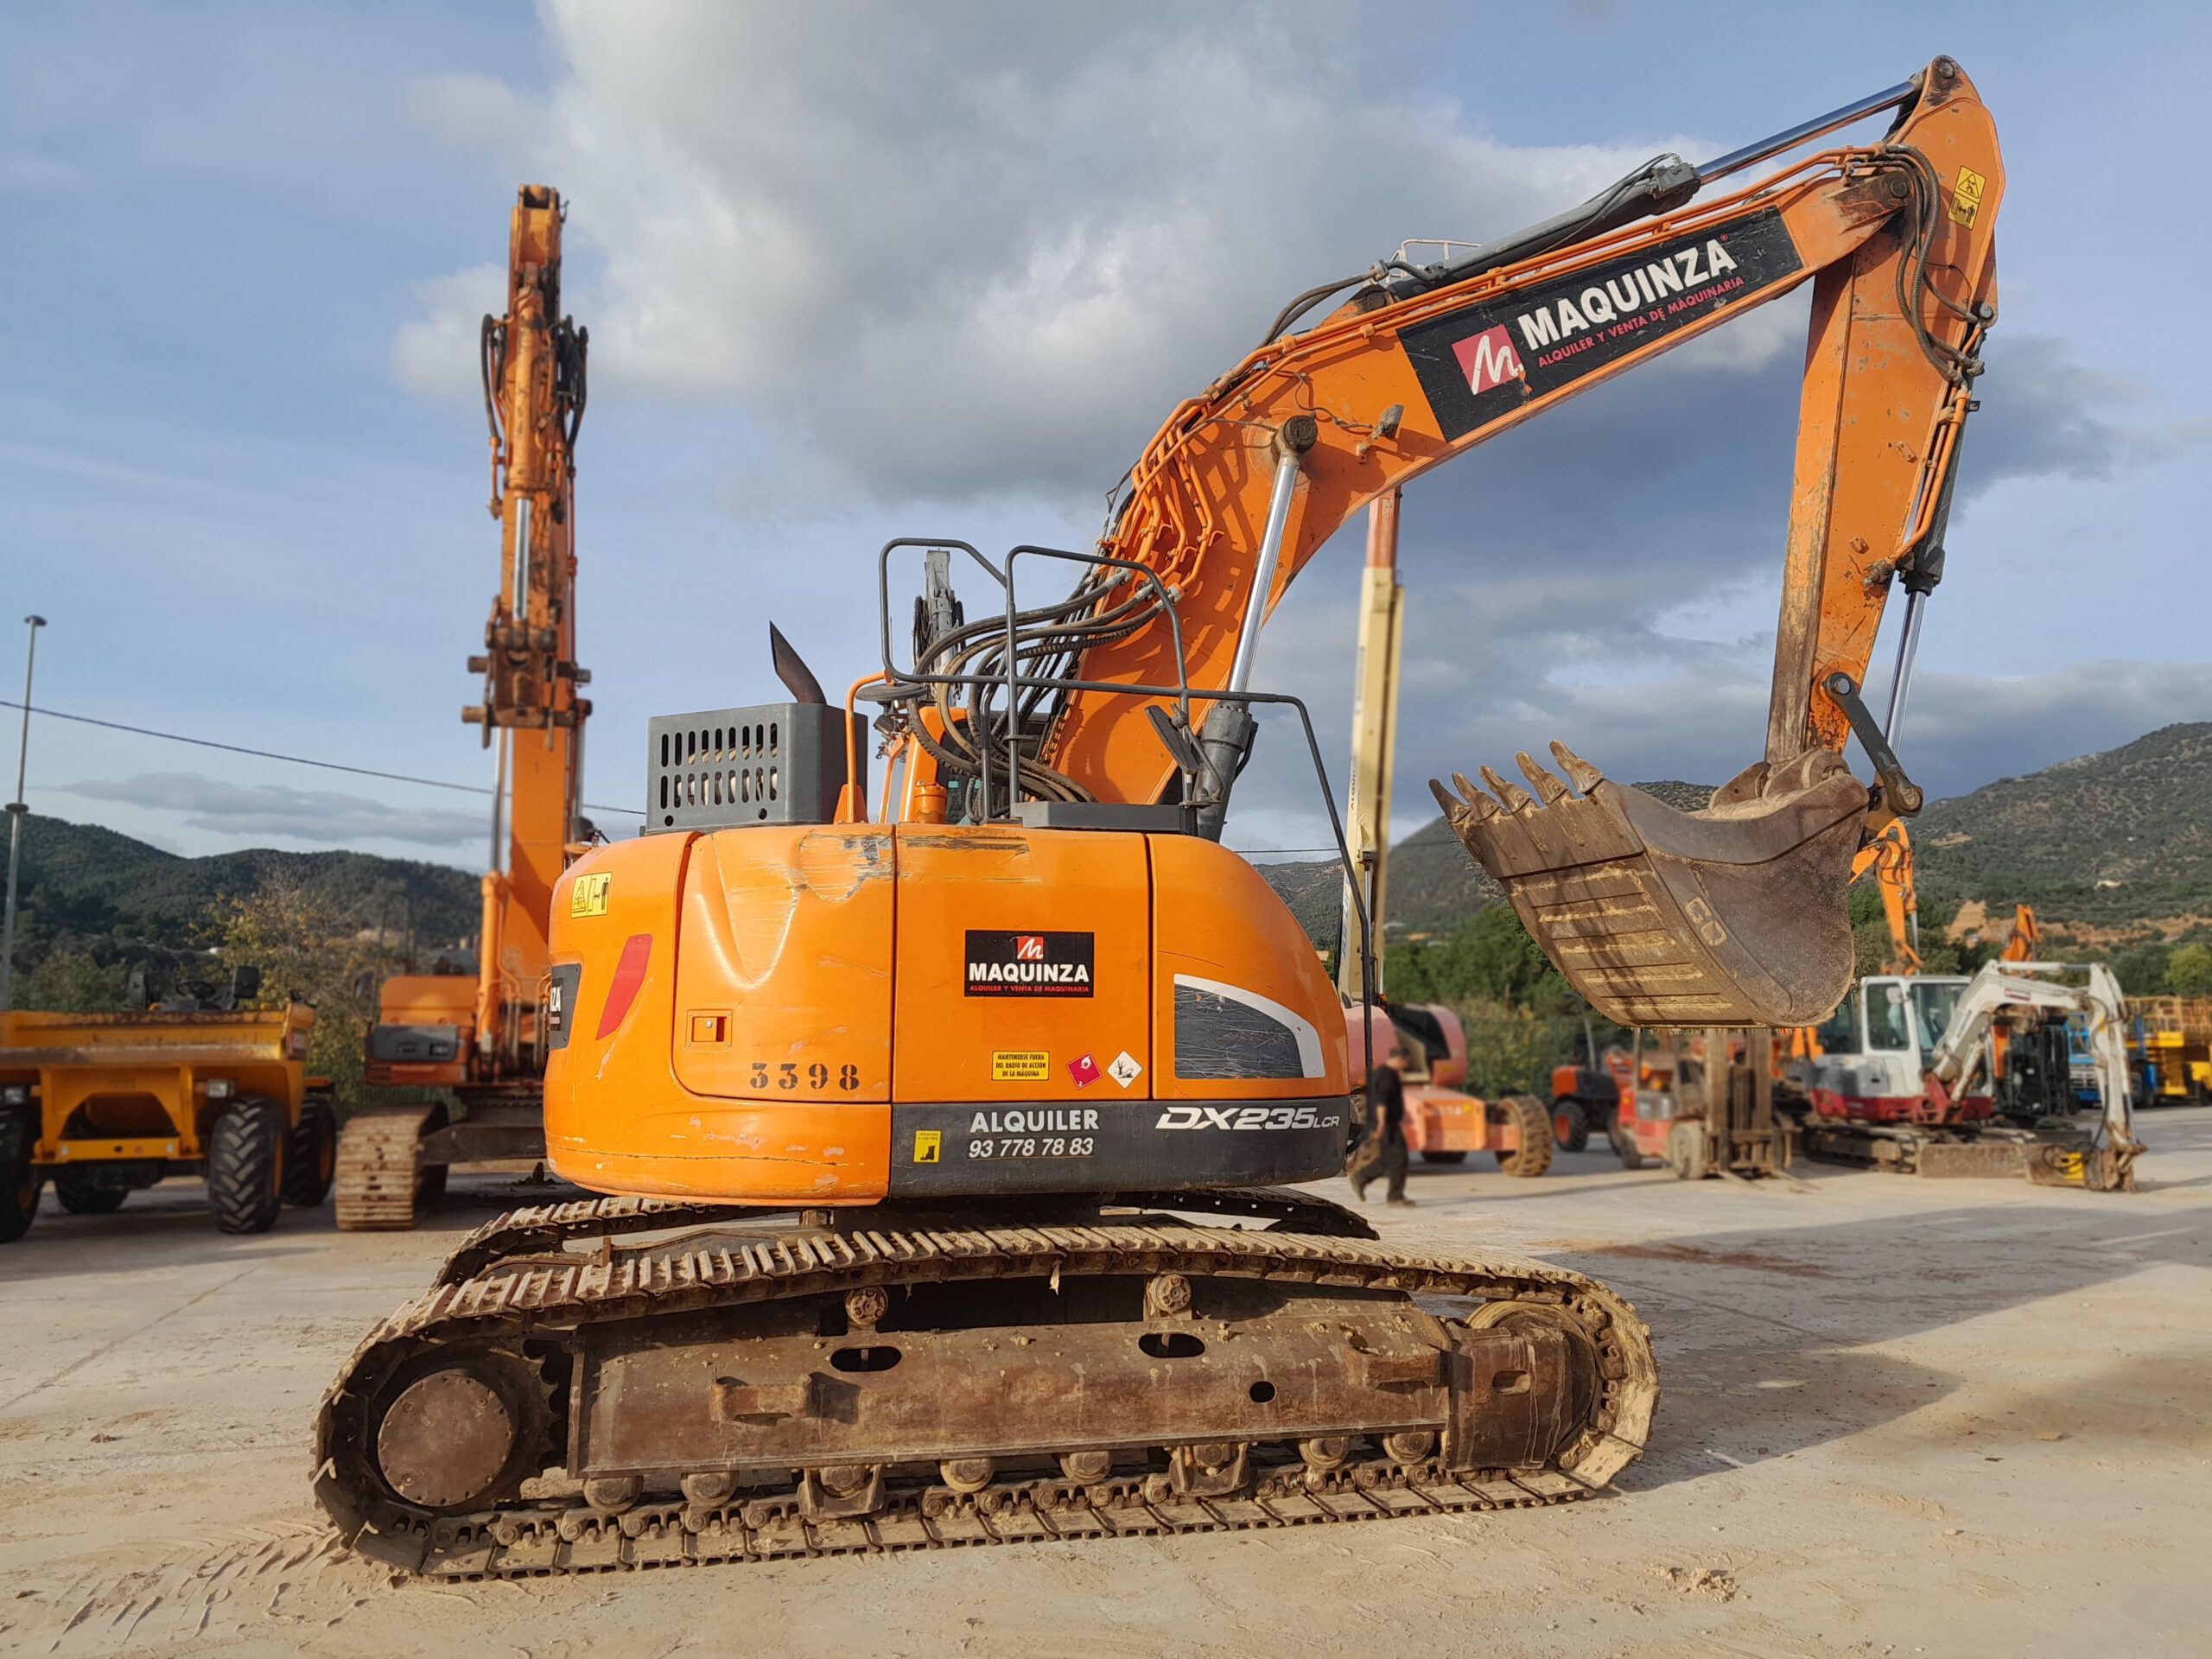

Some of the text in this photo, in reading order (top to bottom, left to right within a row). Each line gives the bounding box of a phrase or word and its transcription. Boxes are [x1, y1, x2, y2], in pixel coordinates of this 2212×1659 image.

[1517, 238, 1738, 351] MAQUINZA
[1538, 276, 1745, 368] ALQUILER Y VENTA DE MAQUINARIA
[969, 963, 1090, 982] MAQUINZA
[750, 1062, 861, 1090] 3398
[969, 1109, 1100, 1133] ALQUILER
[969, 1137, 1095, 1158] 93 778 78 83
